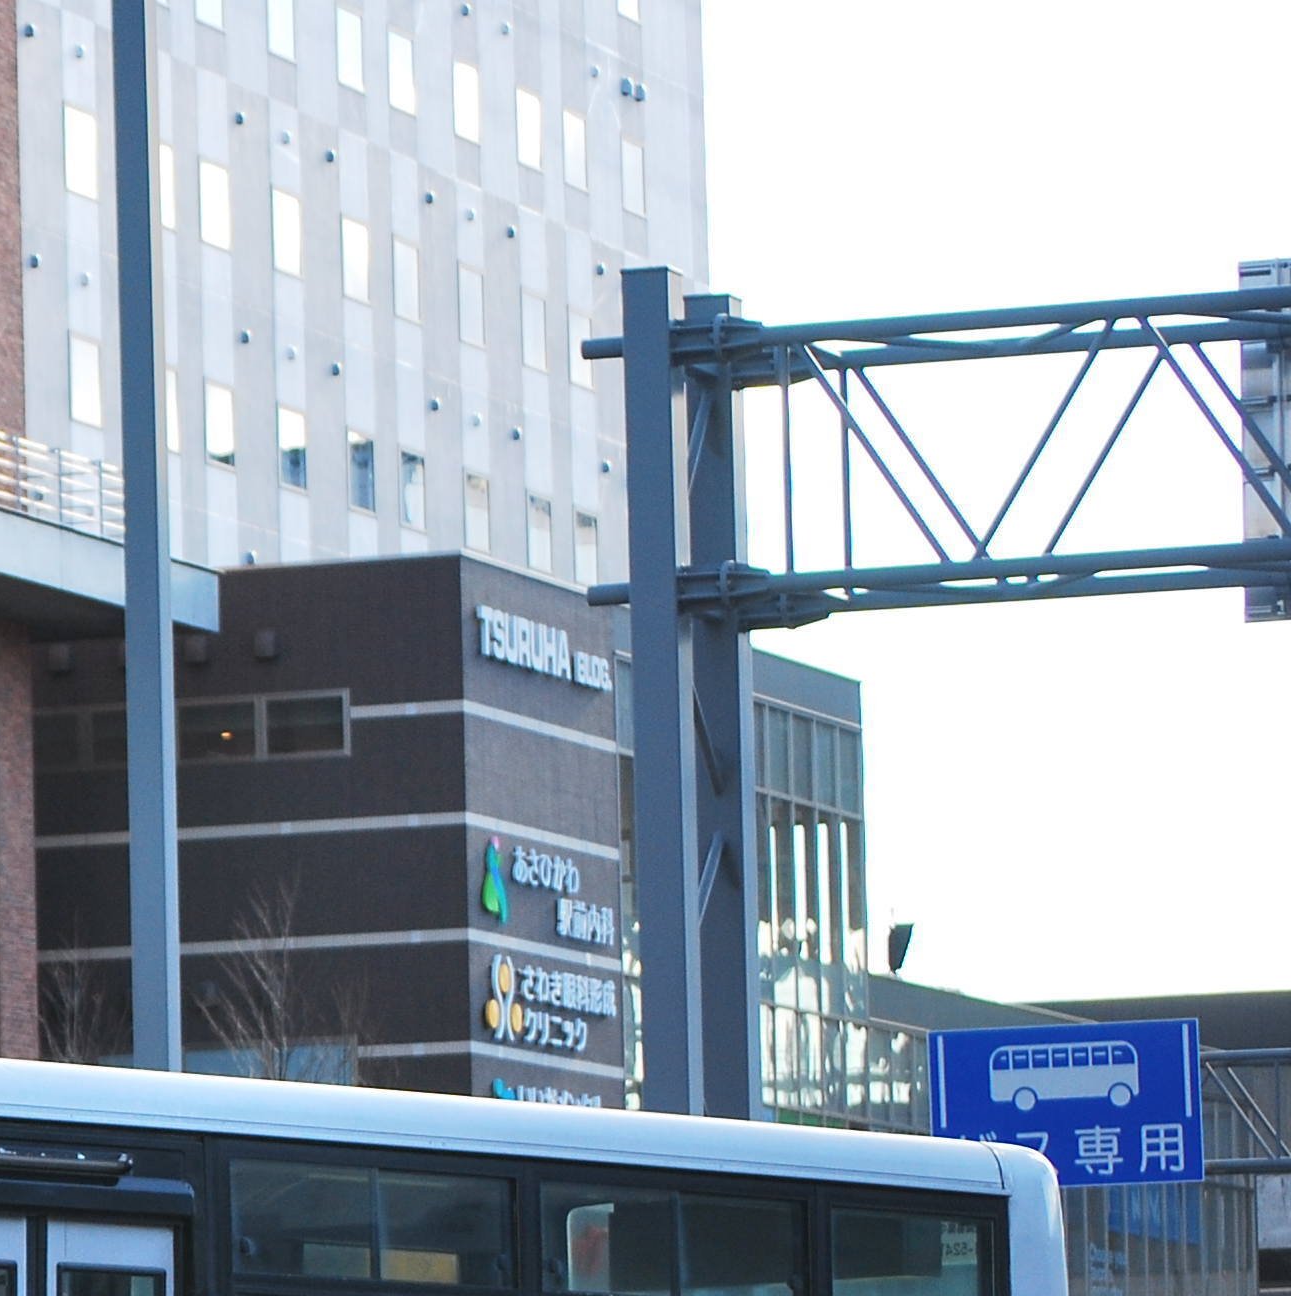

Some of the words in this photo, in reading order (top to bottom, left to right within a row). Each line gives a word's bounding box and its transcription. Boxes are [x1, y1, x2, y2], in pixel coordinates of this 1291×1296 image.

[476, 604, 572, 681] TSURUHA
[512, 845, 580, 894] あさひかわ
[555, 897, 615, 947] 駅前内科
[524, 1008, 588, 1052] クリニック
